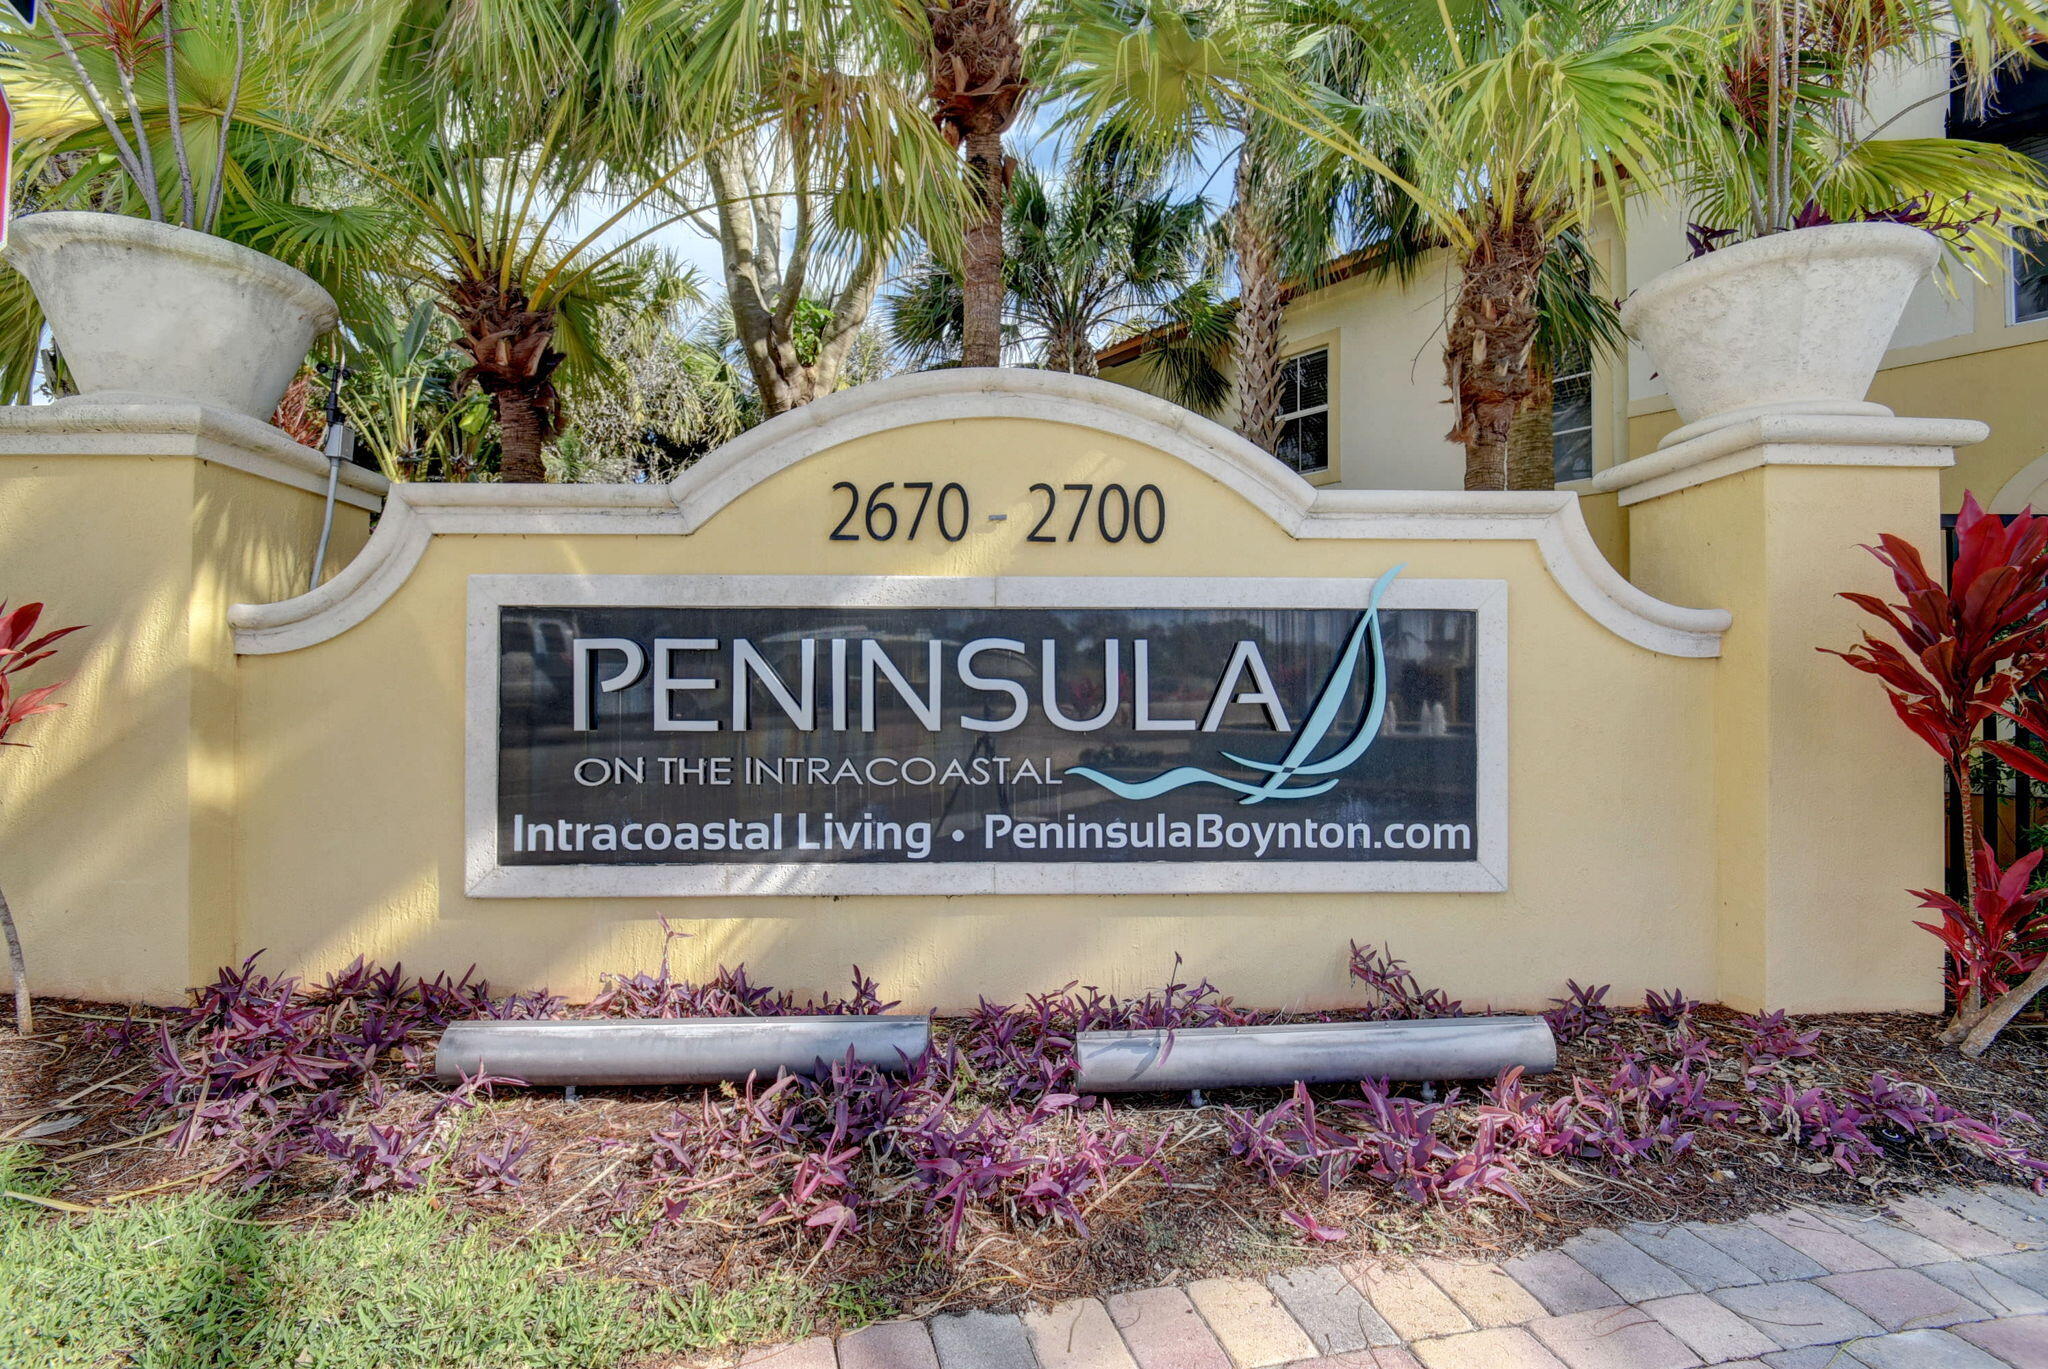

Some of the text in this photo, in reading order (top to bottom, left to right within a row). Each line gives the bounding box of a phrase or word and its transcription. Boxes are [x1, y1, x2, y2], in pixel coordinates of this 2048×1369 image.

[829, 481, 970, 542] 2670
[1026, 482, 1166, 544] 2700
[573, 637, 1292, 733] PENINSULA
[574, 756, 1063, 787] ON THE INTRACOASTAL
[513, 813, 783, 852] Intracoastal
[798, 812, 932, 859] Living
[985, 812, 1471, 858] PeninsulaBoynton.com
